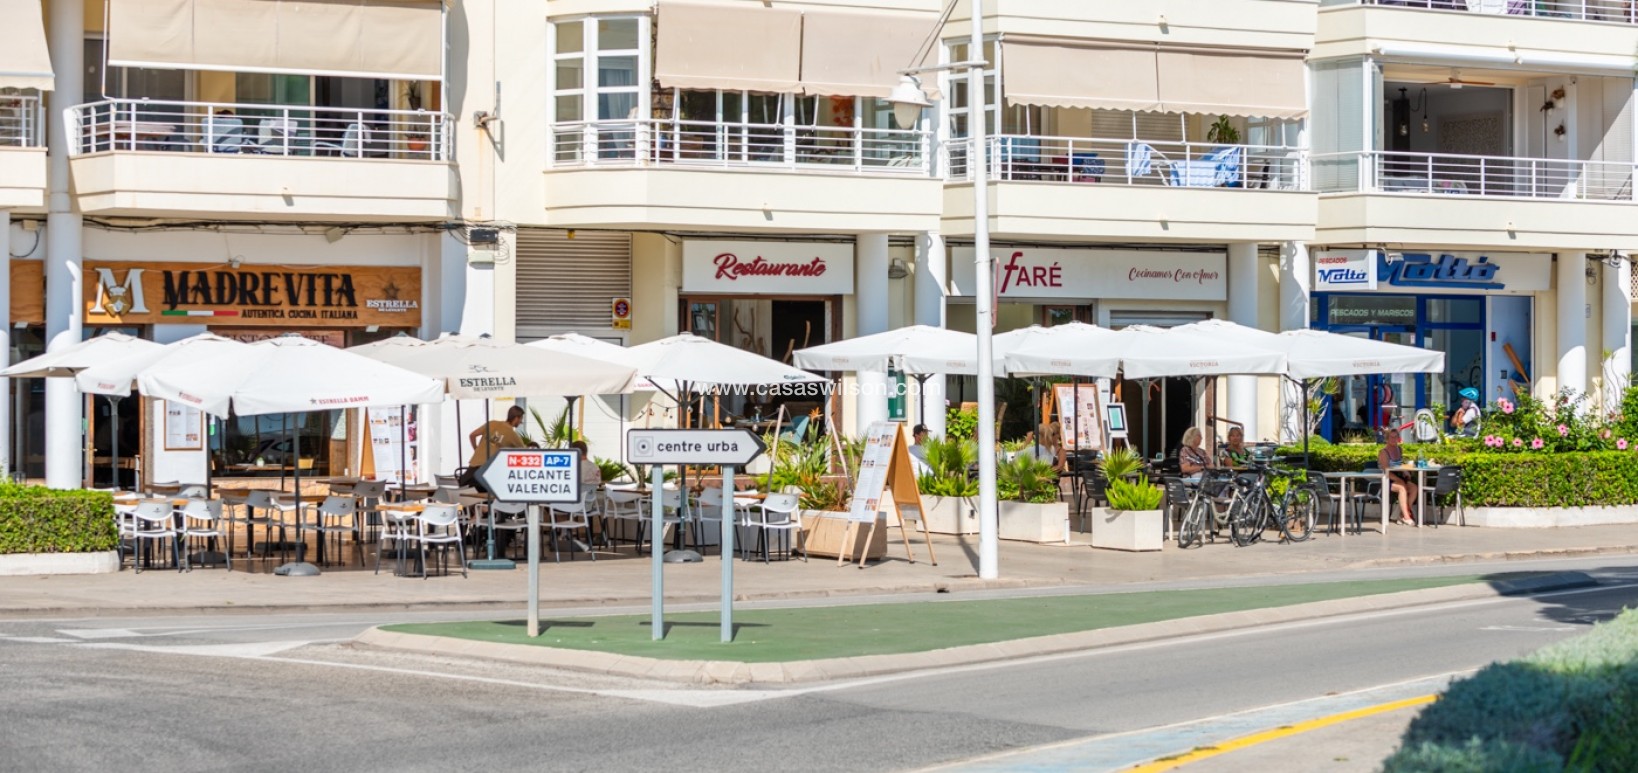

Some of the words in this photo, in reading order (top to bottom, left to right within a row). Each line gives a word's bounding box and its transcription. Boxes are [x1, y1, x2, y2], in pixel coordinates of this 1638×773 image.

[713, 253, 826, 280] Restaurante
[1129, 267, 1172, 281] Cocinamos
[1174, 268, 1191, 282] Con
[1193, 269, 1218, 284] Amor
[89, 268, 150, 314] M
[162, 271, 358, 311] MADREVITA
[366, 299, 418, 308] ESTRELLA
[241, 309, 285, 319] AUTENTICA
[288, 309, 317, 319] CUCINA
[320, 310, 358, 320] ITALIANA
[1330, 309, 1368, 317] PESCADOS
[1371, 309, 1376, 317] Y
[1377, 309, 1414, 317] MARISCOS
[459, 377, 517, 388] ESTRELLA
[657, 441, 702, 452] centre
[508, 456, 541, 465] N-332
[546, 456, 570, 465] AP-7
[508, 470, 571, 480] ALICANTE
[507, 483, 571, 494] VALENCIA
